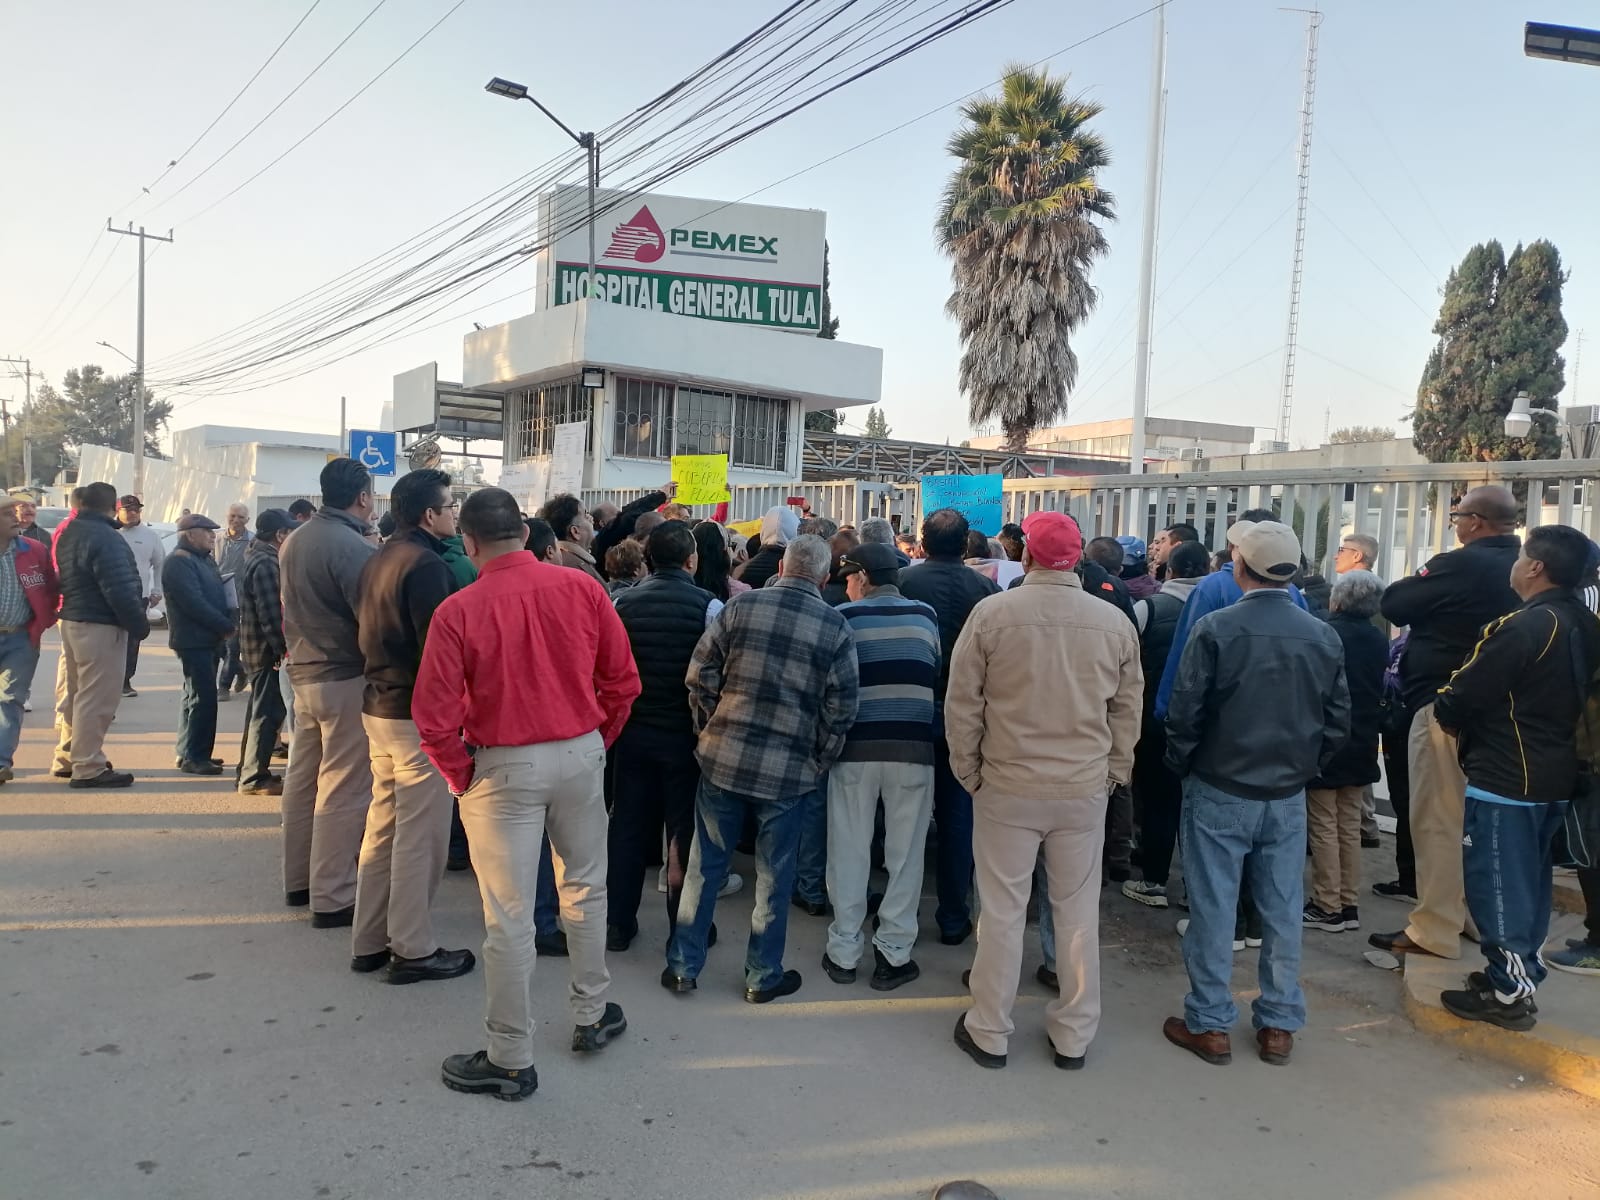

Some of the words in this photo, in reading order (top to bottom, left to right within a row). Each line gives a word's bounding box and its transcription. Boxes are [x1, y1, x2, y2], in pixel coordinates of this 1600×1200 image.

[670, 228, 778, 256] PEMEX
[562, 270, 664, 312] HOSPITAL
[668, 279, 763, 320] GENERAL
[768, 287, 817, 325] TULA
